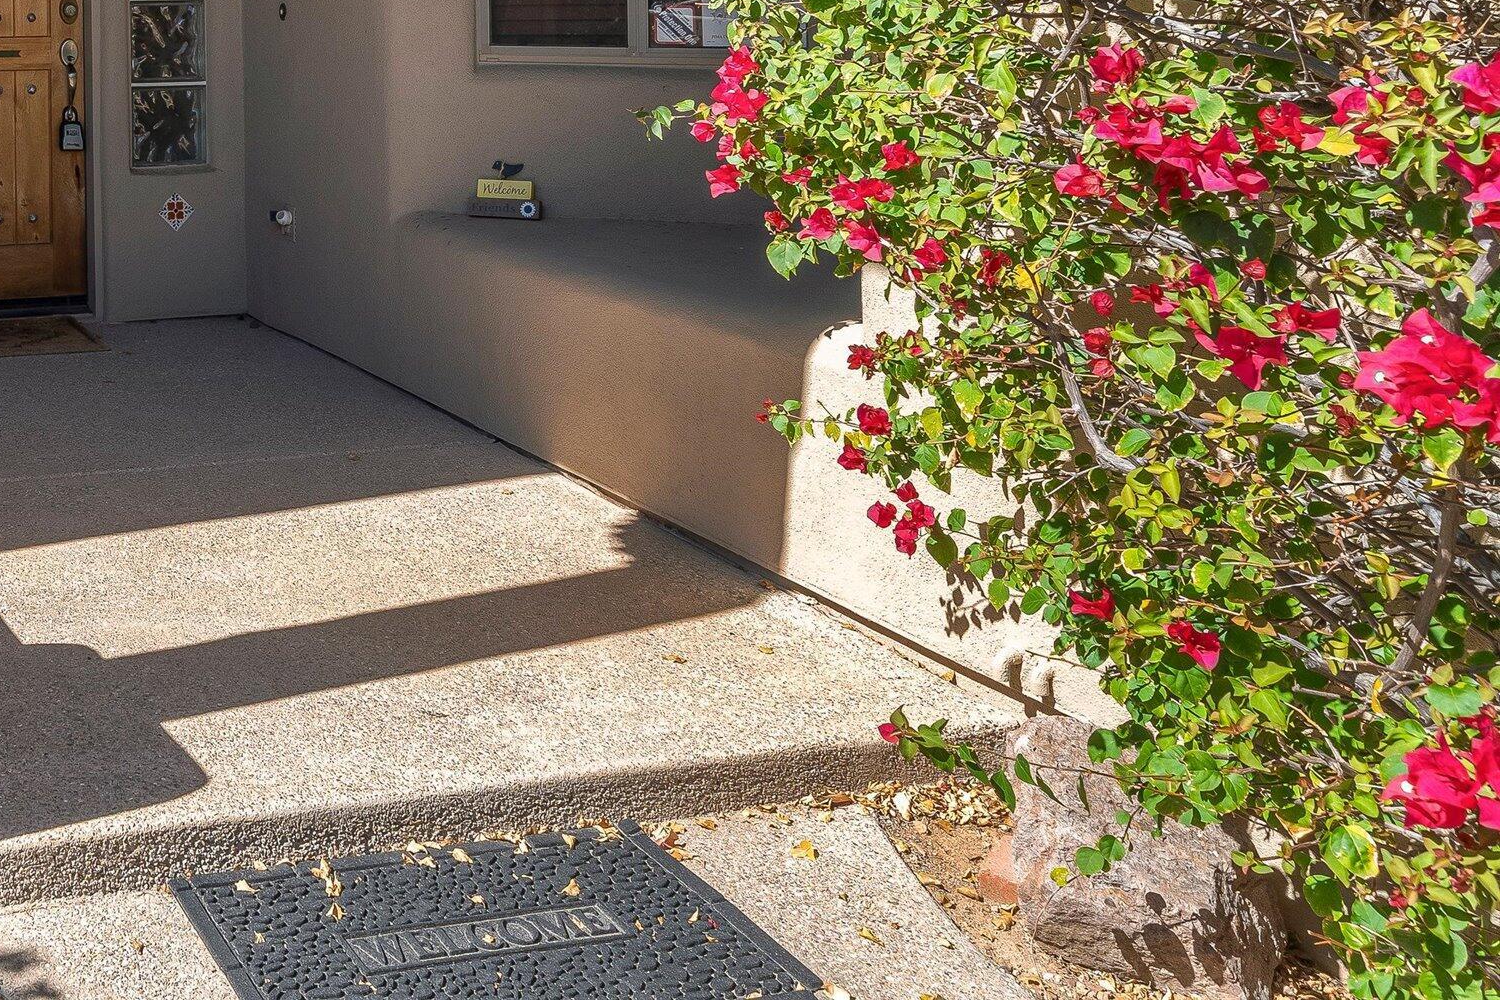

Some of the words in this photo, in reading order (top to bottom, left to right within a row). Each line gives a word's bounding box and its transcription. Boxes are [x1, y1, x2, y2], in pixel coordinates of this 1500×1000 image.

[658, 10, 687, 37] Protection
[483, 182, 527, 196] Welcome
[351, 908, 613, 966] WELCOME
